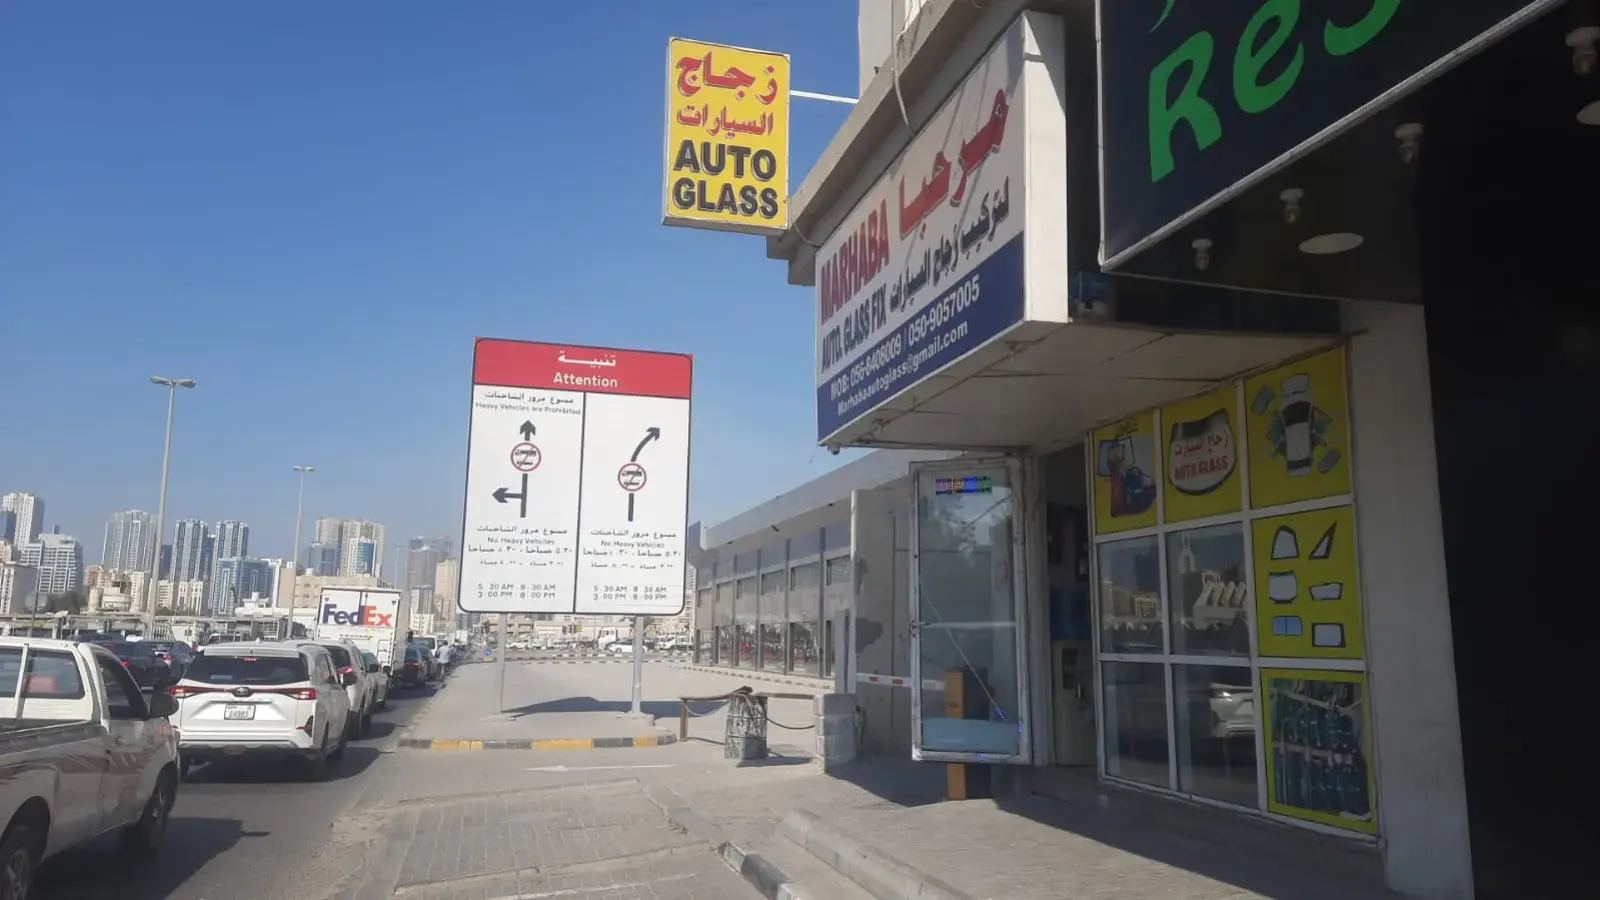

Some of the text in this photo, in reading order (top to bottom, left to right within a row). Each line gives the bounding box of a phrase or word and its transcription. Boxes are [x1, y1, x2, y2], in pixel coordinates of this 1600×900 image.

[677, 52, 778, 104] زجاج
[677, 104, 774, 139] السيارات
[673, 140, 776, 181] AUTO
[900, 88, 1010, 240] مرحبا
[673, 178, 779, 219] GLASS
[820, 198, 890, 326] MARHABA
[890, 176, 1009, 313] لتركيب زجاج السيارات
[831, 378, 849, 401] MOB:
[908, 274, 980, 346] 050-9057005
[844, 298, 870, 355] GLASS
[871, 283, 887, 334] FIX
[484, 390, 525, 400] الشاحنات
[553, 372, 618, 388] Attention
[475, 402, 498, 410] Heavy
[500, 403, 529, 412] Vehicles
[544, 406, 581, 415] Prohibited
[1175, 455, 1228, 480] AUTO GLASS
[590, 528, 629, 536] الشاحنات
[322, 604, 392, 626] FedEx
